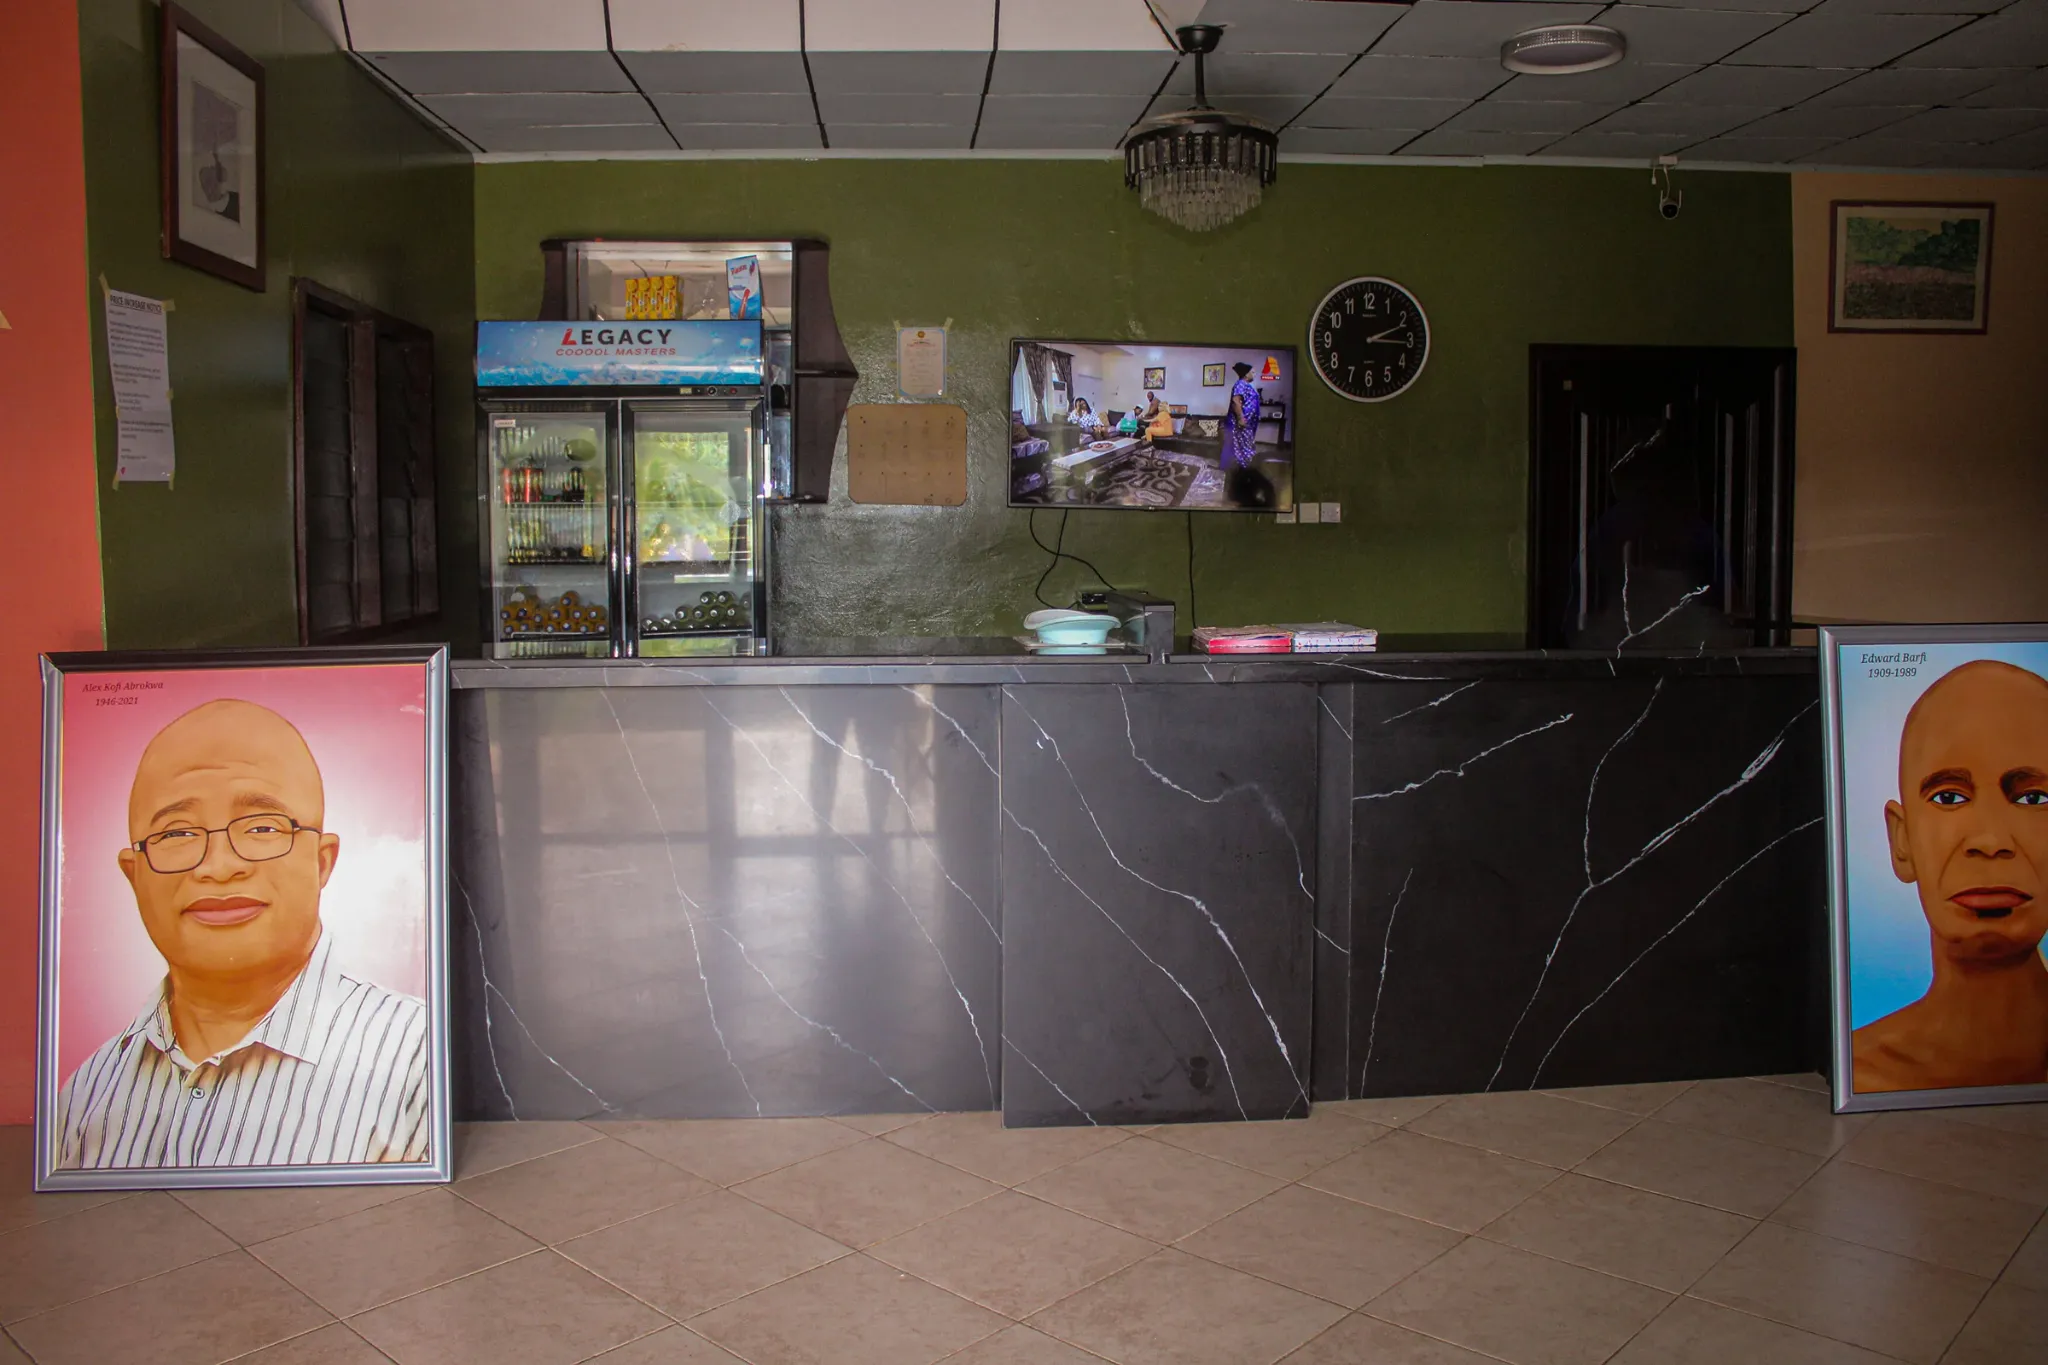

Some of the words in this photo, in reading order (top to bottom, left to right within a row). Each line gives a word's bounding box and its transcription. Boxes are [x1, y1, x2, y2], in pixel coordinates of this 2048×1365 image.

[110, 295, 123, 305] PRICE
[124, 298, 146, 310] INCREASE
[146, 303, 162, 313] NOTICE
[1345, 298, 1354, 315] 11
[1363, 292, 1375, 309] 12
[1385, 297, 1390, 314] 1
[1330, 311, 1342, 329] 10
[1399, 310, 1407, 327] 2
[561, 328, 672, 345] LEGACY
[1324, 331, 1332, 349] 9
[1406, 332, 1414, 348] 3
[556, 348, 609, 356] COOOOL
[615, 347, 677, 356] MASTERS
[1330, 352, 1339, 369] 8
[1398, 352, 1406, 369] 4
[1348, 366, 1355, 383] 7
[1364, 370, 1373, 387] 6
[1383, 366, 1391, 383] 5
[1860, 652, 1900, 664] Edward
[1902, 652, 1927, 665] Barfi
[1868, 667, 1917, 678] 1909-1989
[82, 683, 102, 693] Alex
[103, 683, 122, 693] Kofi
[123, 681, 164, 691] Abrokwa
[95, 697, 139, 706] 1946-2021
